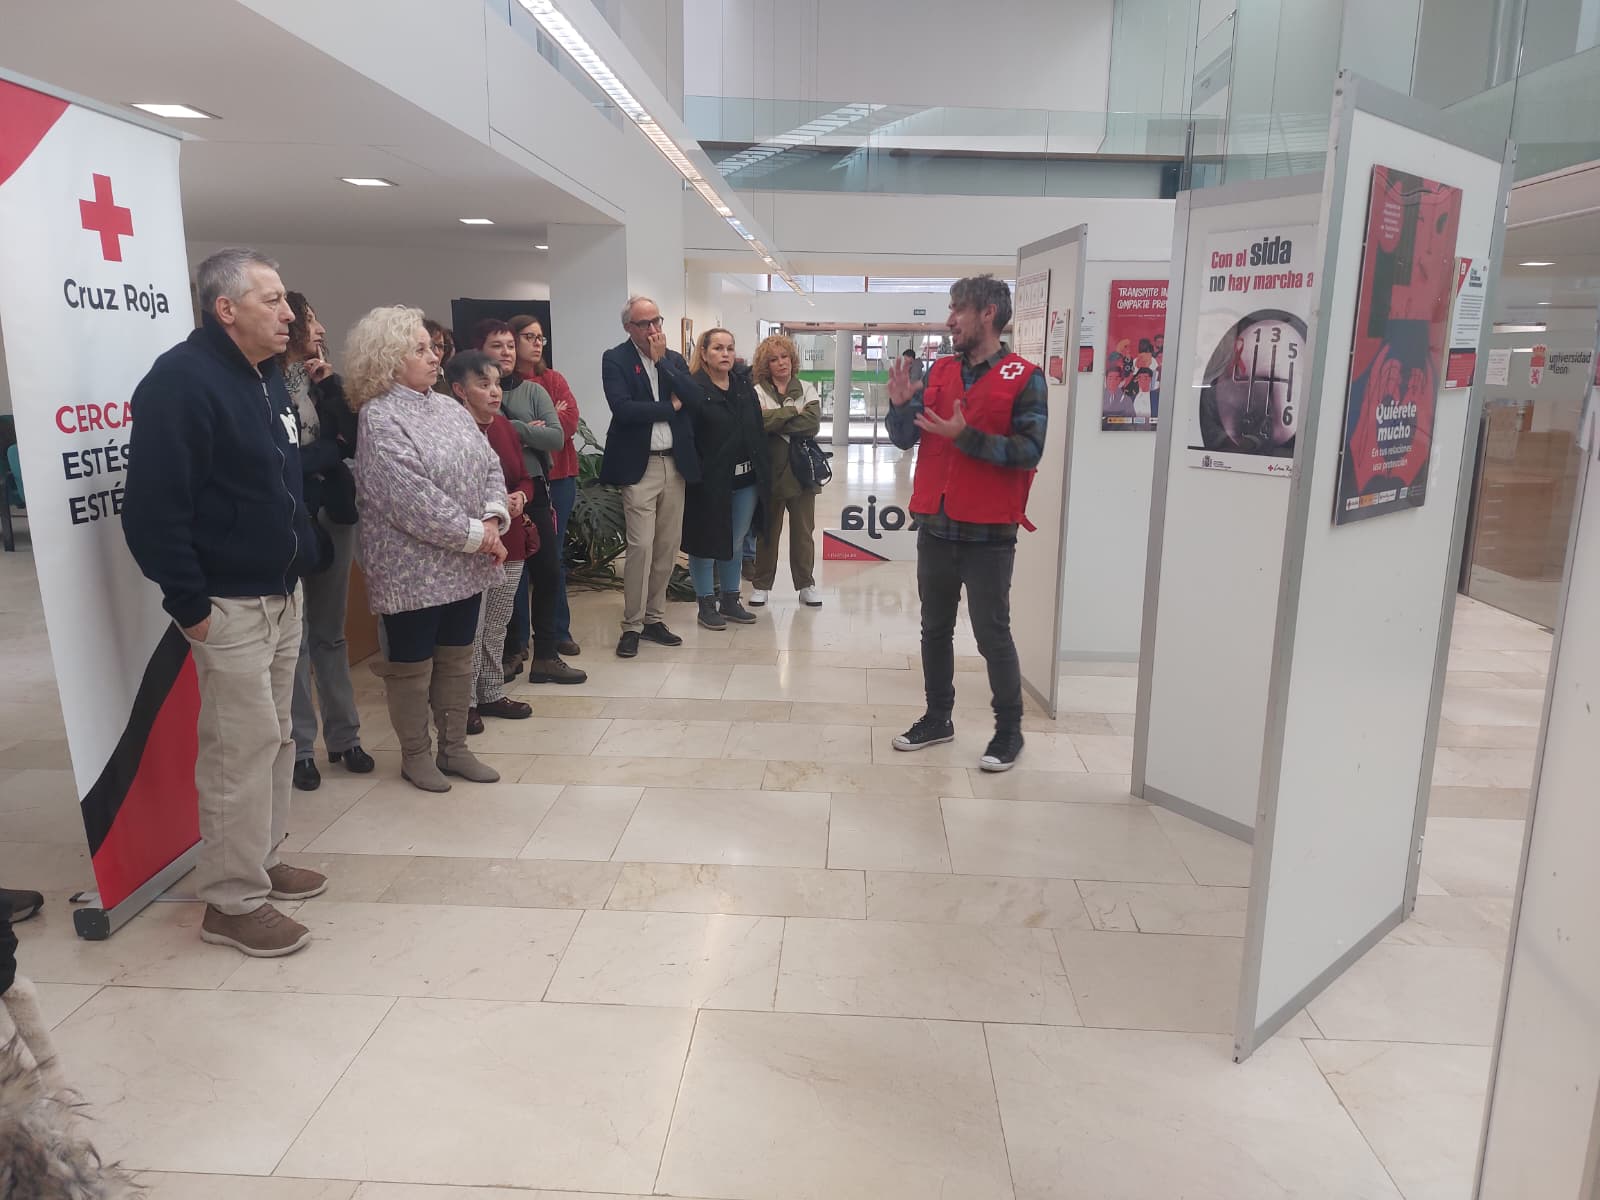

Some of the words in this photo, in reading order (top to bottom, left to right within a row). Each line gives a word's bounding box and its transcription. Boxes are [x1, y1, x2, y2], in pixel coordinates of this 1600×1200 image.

[1211, 251, 1233, 269] Con
[1235, 249, 1247, 268] el
[1249, 236, 1291, 266] sida
[1209, 275, 1226, 292] no
[1228, 274, 1251, 293] hay
[1253, 270, 1303, 290] marcha
[63, 278, 119, 310] Cruz
[123, 283, 170, 320] Roja
[1118, 287, 1159, 298] TRANSMITE
[1152, 299, 1167, 309] PRE
[1254, 328, 1262, 343] 1
[1271, 327, 1281, 343] 3
[1288, 343, 1298, 359] 5
[1549, 351, 1592, 364] universidad
[55, 401, 134, 434] CERCA
[1282, 405, 1293, 426] 6
[1376, 399, 1417, 424] Quiérete
[1377, 423, 1411, 442] mucho
[62, 438, 130, 481] ESTÉS
